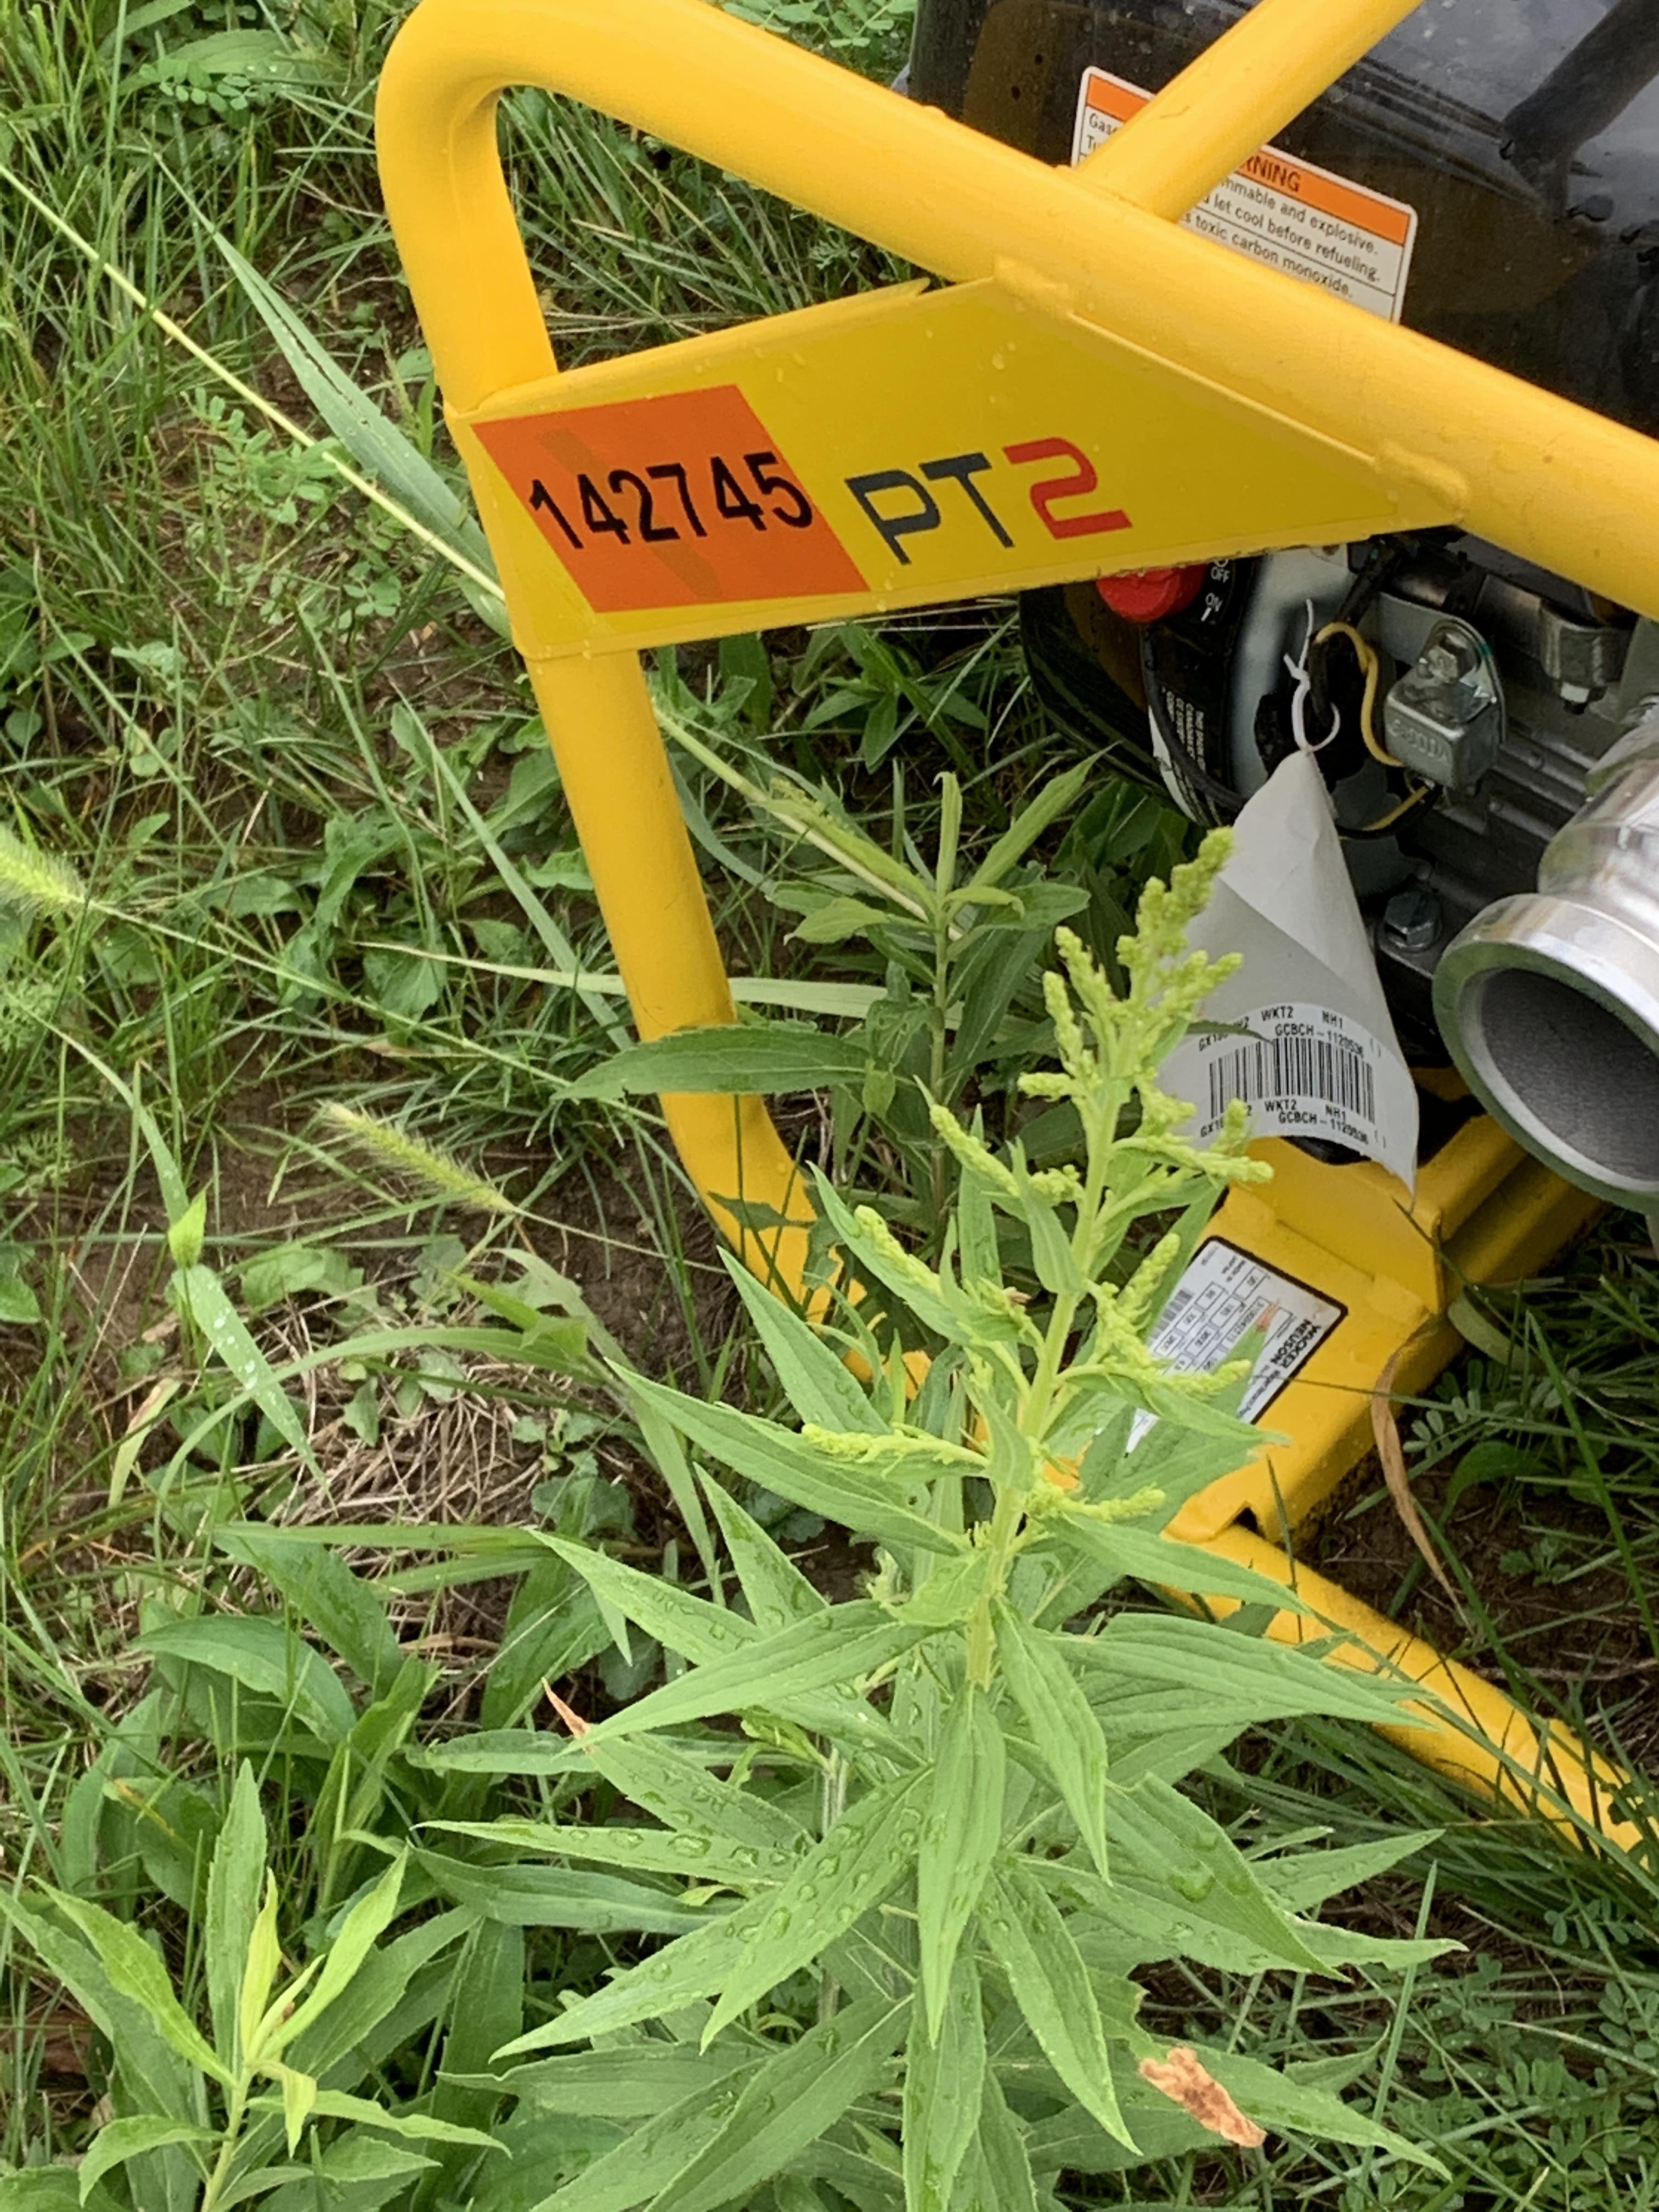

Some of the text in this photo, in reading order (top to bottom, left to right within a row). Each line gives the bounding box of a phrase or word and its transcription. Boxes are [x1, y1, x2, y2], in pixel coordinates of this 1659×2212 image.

[1214, 194, 1380, 283] let cool before refueling.
[1280, 204, 1307, 224] and
[1310, 216, 1379, 256] explosive.
[1195, 215, 1353, 297] toxic carbon monoxide.
[529, 451, 813, 550] 142745
[845, 436, 1133, 566] PT2
[1210, 566, 1231, 584] OFF
[1205, 592, 1224, 612] ON
[1261, 1006, 1294, 1022] WKT2
[1322, 1010, 1343, 1029] NH1
[1265, 1099, 1297, 1113] WKT2
[1325, 1104, 1346, 1121] NH1
[1270, 1319, 1312, 1364] NEUSON
